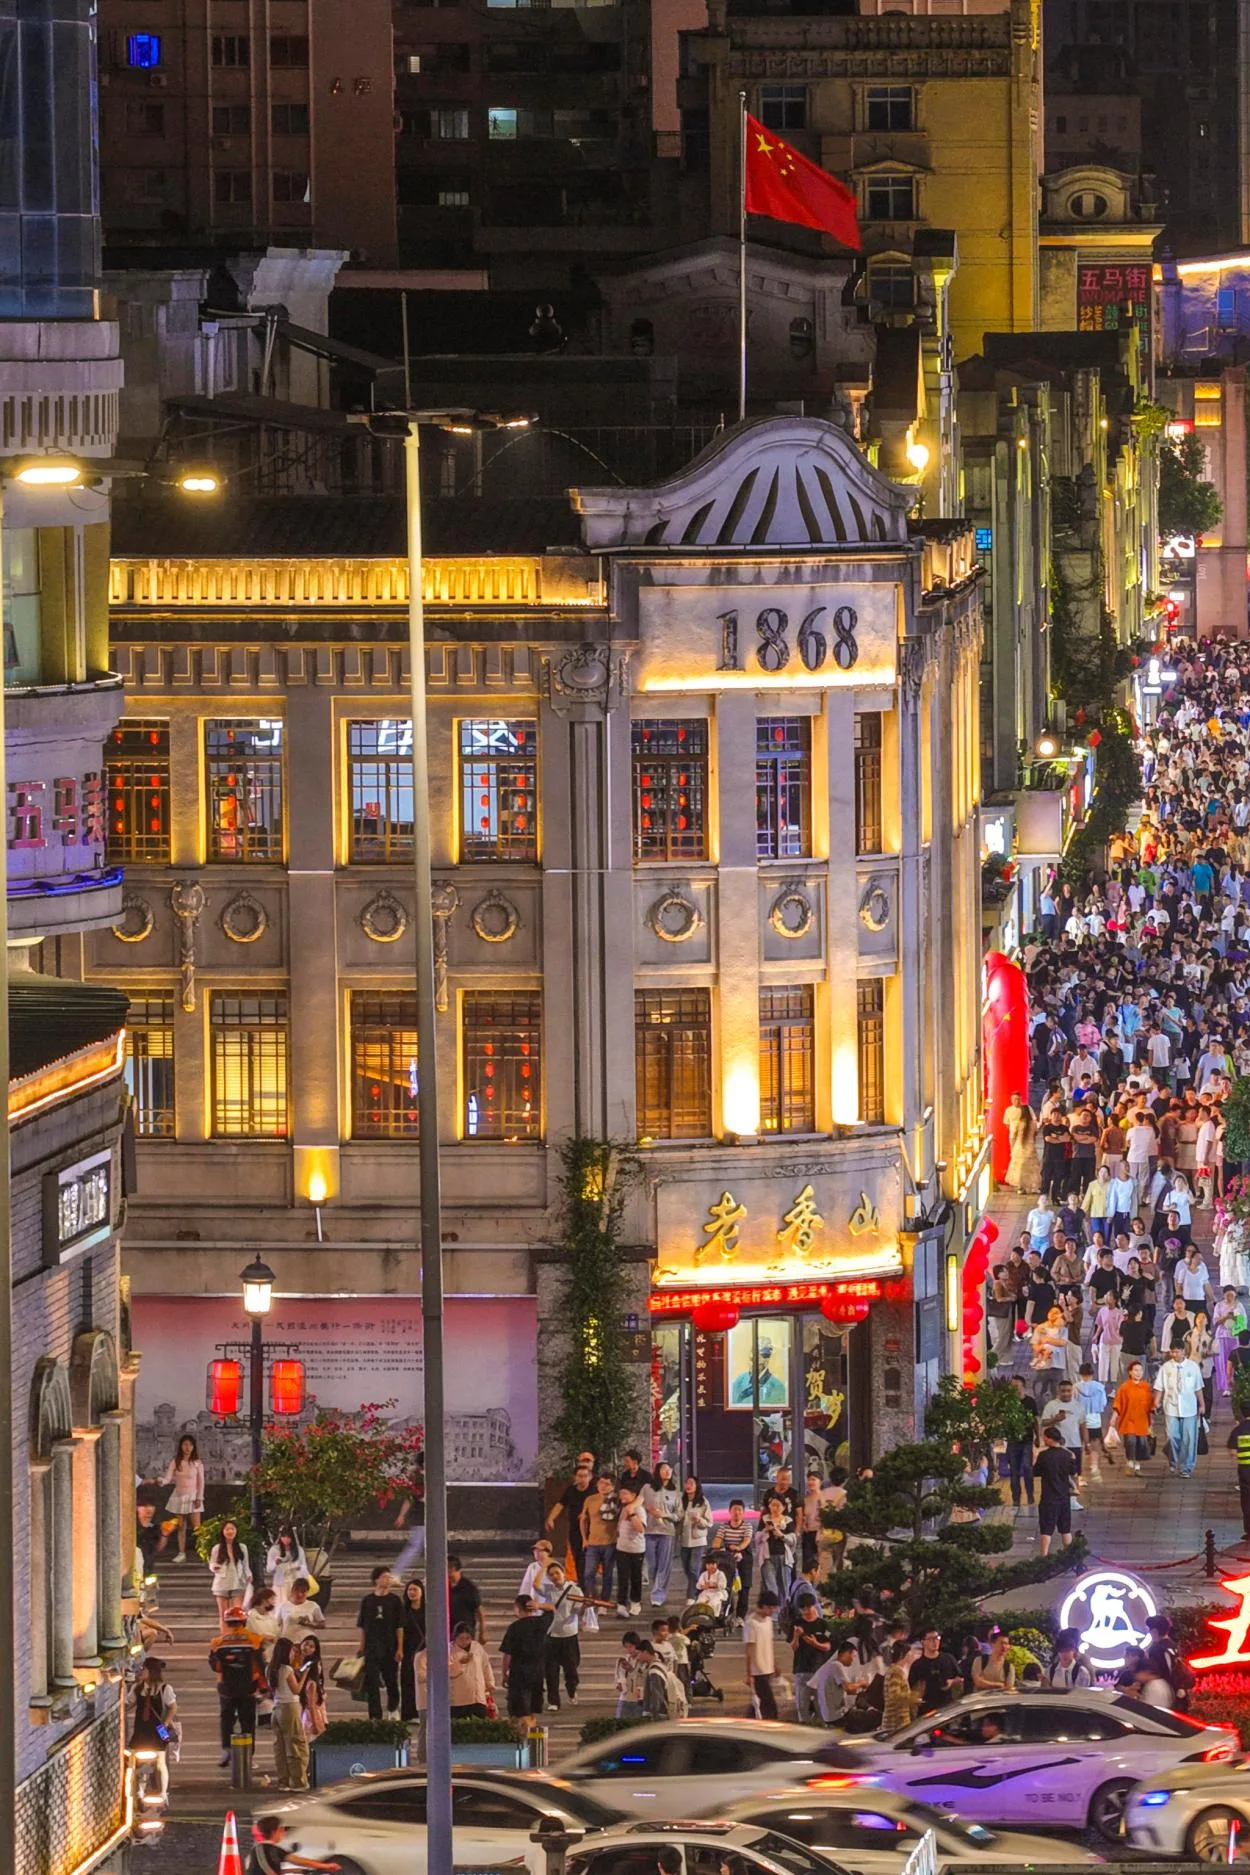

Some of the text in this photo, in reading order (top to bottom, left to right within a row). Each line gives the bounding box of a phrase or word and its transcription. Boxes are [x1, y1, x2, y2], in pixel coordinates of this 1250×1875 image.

[1080, 268, 1147, 290] 五马街
[716, 606, 859, 673] 1868
[696, 1184, 879, 1258] 老香山
